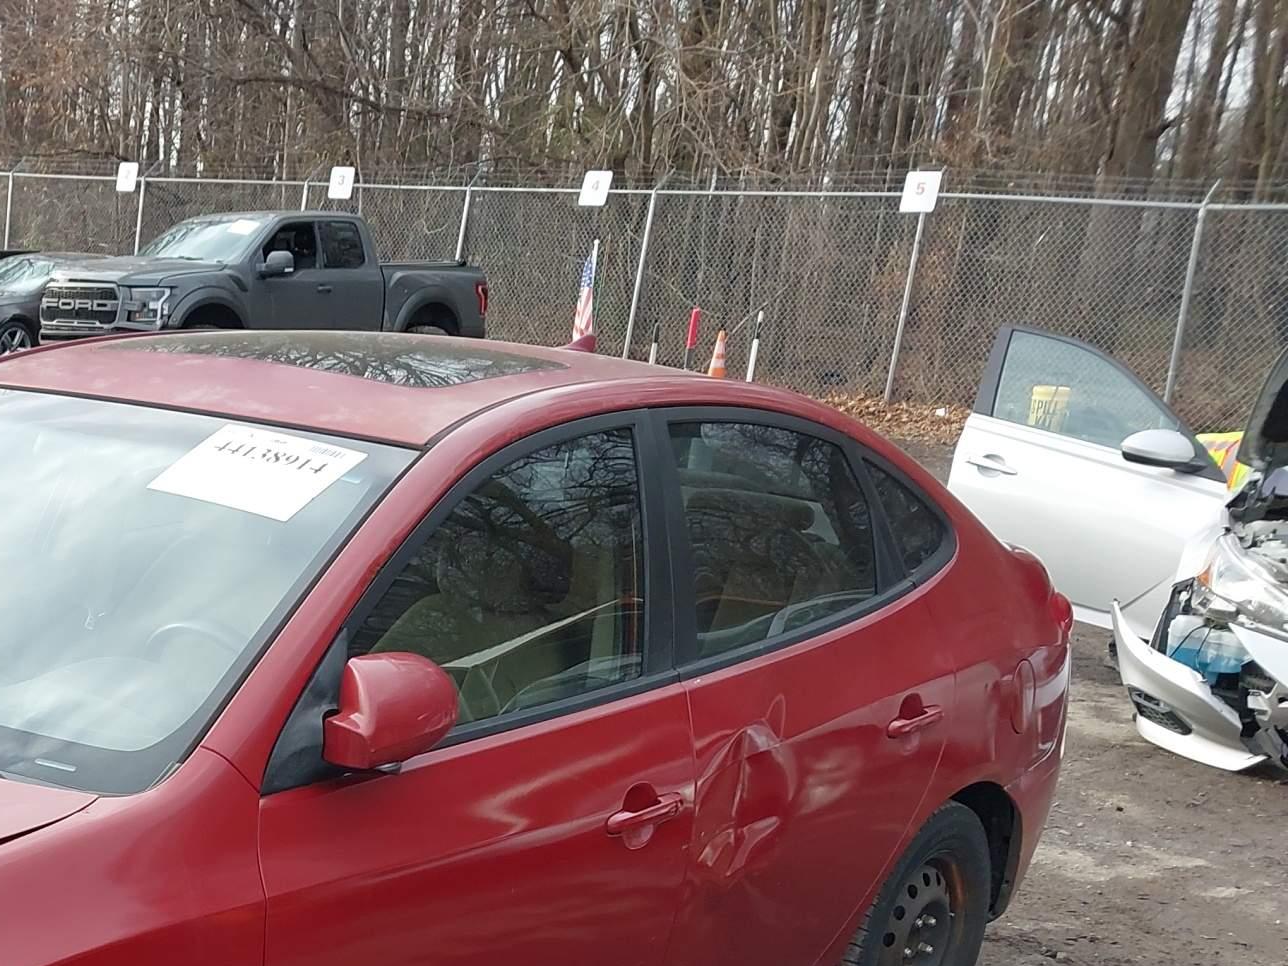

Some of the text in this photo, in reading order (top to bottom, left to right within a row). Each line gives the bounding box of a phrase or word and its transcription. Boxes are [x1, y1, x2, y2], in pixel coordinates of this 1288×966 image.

[338, 175, 346, 185] 3
[591, 179, 600, 191] 4
[915, 182, 926, 195] 5
[42, 298, 110, 311] FORD
[1031, 400, 1058, 415] SPILL
[214, 440, 328, 474] 44138914
